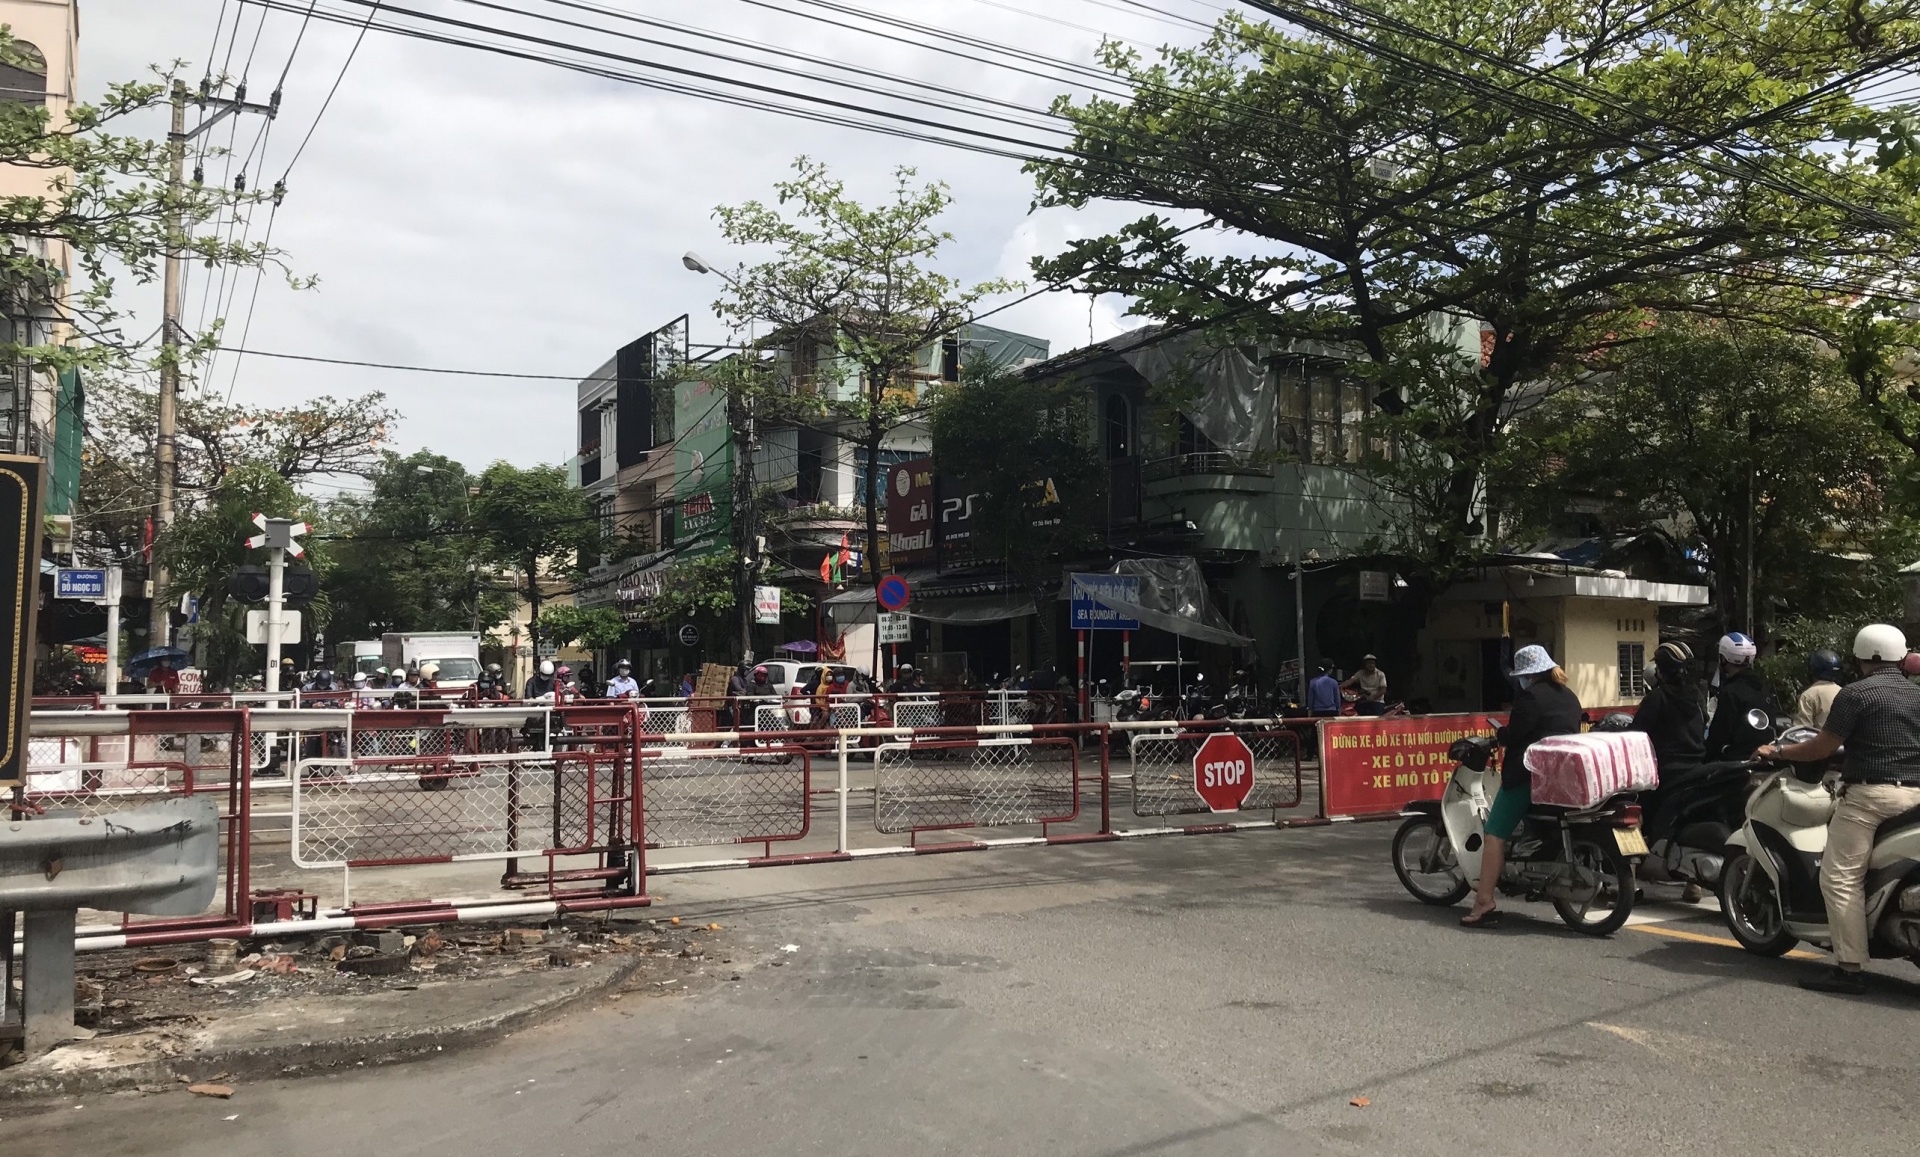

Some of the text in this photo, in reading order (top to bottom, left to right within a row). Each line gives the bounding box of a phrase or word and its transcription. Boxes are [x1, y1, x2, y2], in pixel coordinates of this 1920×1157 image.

[910, 499, 928, 522] GÀ
[889, 531, 925, 553] Khoai
[72, 582, 91, 594] NGỌC
[91, 583, 101, 592] DU
[1077, 609, 1089, 620] SEA
[1089, 609, 1118, 621] BOUNDARY
[180, 671, 201, 683] CƠM
[1389, 734, 1400, 747] XE
[1402, 732, 1417, 749] TẠI
[1417, 731, 1433, 745] NƠI
[1372, 755, 1391, 769] XE
[1395, 752, 1405, 767] Ô
[1407, 750, 1426, 767] TÔ
[1204, 759, 1245, 788] STOP
[1372, 775, 1391, 789] XE
[1395, 771, 1419, 787] MÔ
[1421, 769, 1440, 785] TÔ
